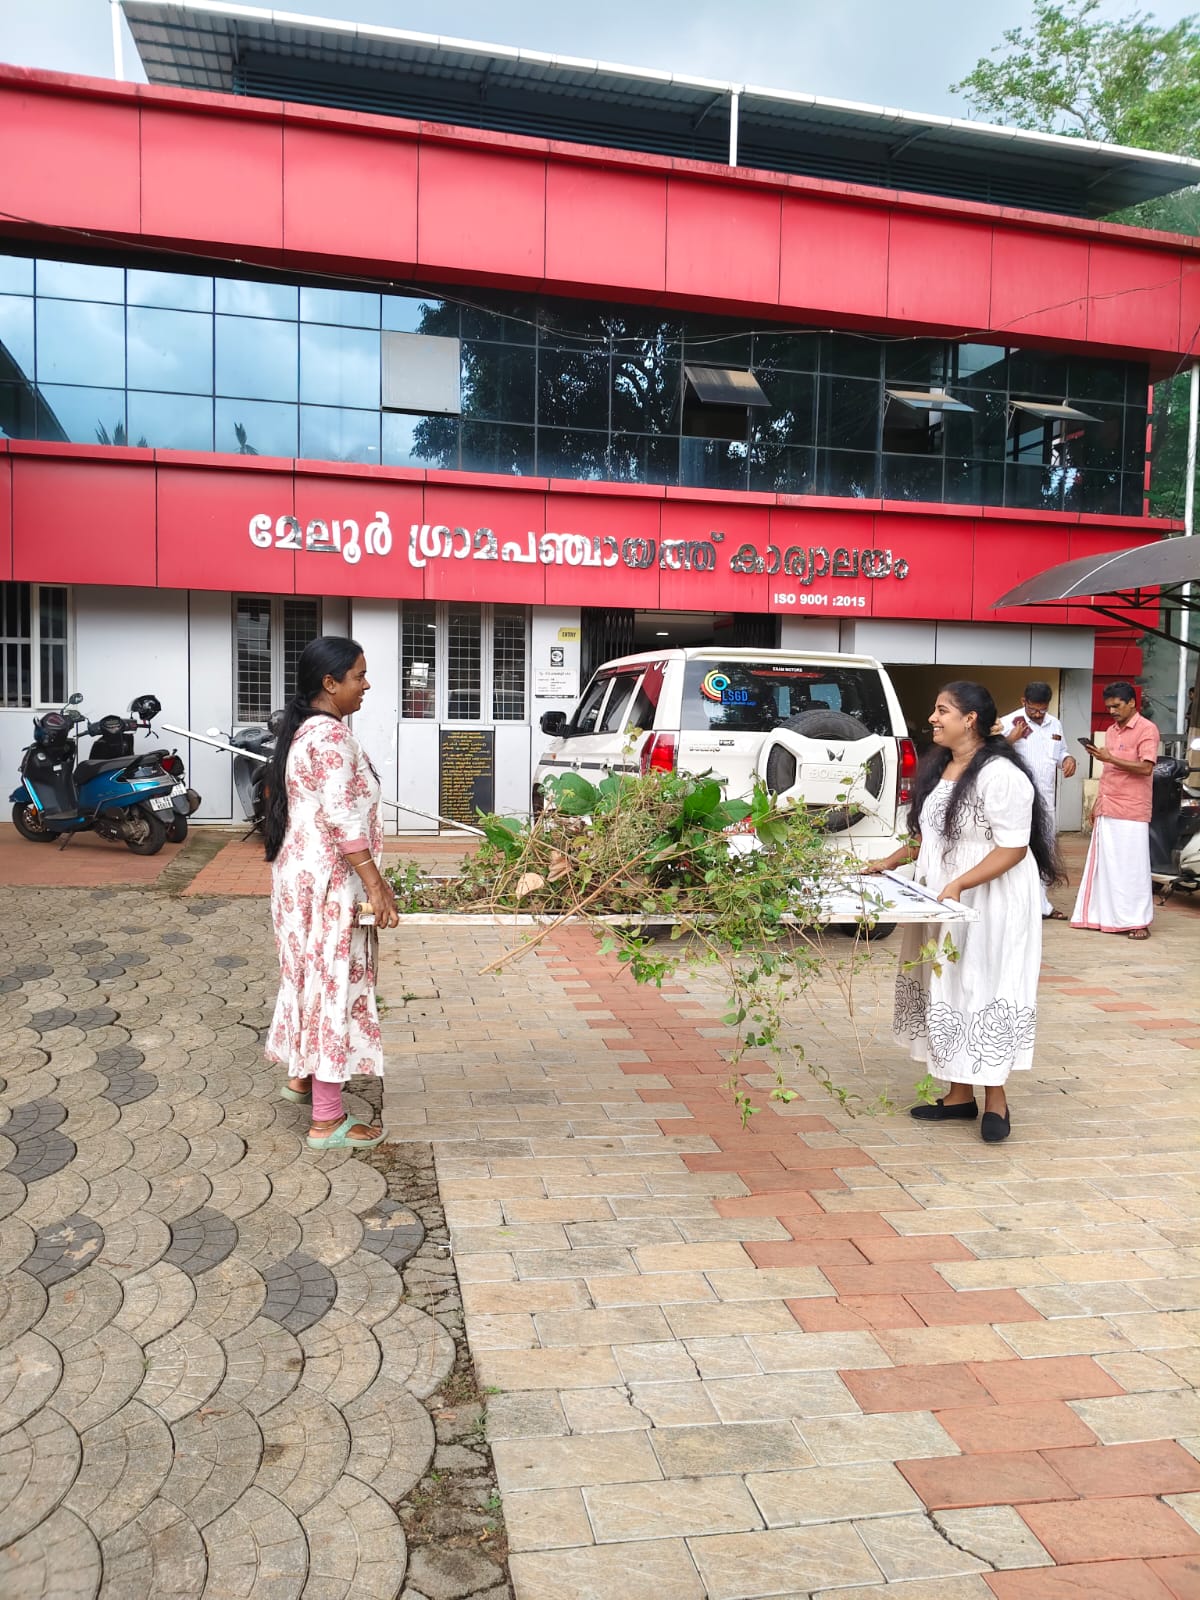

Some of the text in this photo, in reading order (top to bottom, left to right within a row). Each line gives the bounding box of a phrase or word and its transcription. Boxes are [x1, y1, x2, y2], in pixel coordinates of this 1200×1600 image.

[249, 511, 909, 585] മേലൂർ ഗ്രാമപഞ്ചായത്ത് കാര്യാലയം
[774, 593, 865, 607] ISO 9001 :2015
[722, 690, 748, 701] LSGD
